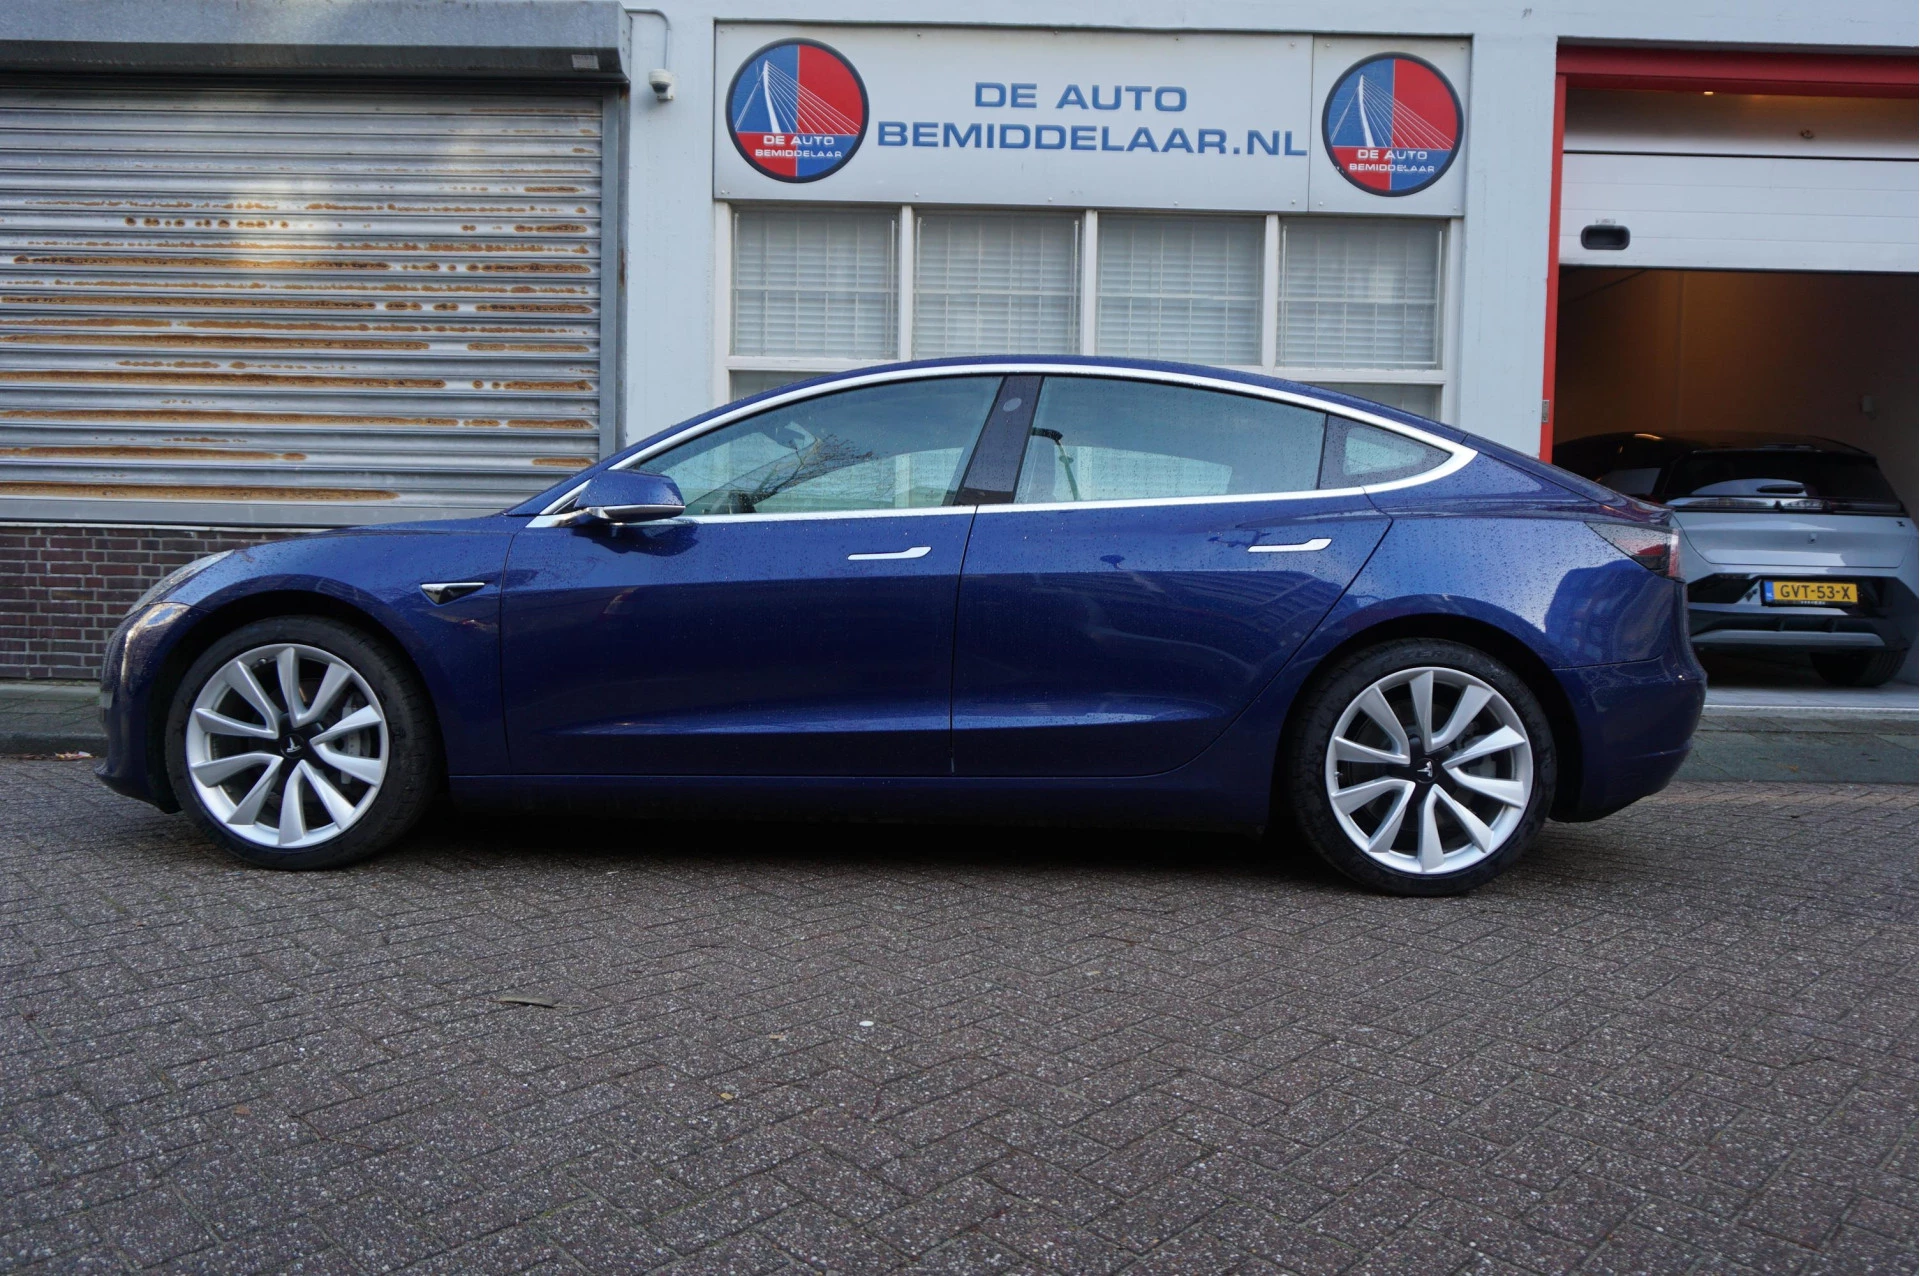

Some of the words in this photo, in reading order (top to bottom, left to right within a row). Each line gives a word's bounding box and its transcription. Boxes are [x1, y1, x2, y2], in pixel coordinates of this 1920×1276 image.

[974, 82, 1038, 109] DE
[1055, 84, 1188, 112] AUTO
[763, 135, 785, 145] DE
[790, 135, 835, 146] AUTO
[877, 121, 1308, 156] BEMIDDELAAR.NL
[755, 148, 842, 158] BEMIDDELAAR
[1357, 149, 1379, 159] DE
[1383, 150, 1428, 160] AUTO
[1349, 163, 1435, 173] BEMIDDELAAR
[1780, 584, 1851, 600] GVT-53-X
